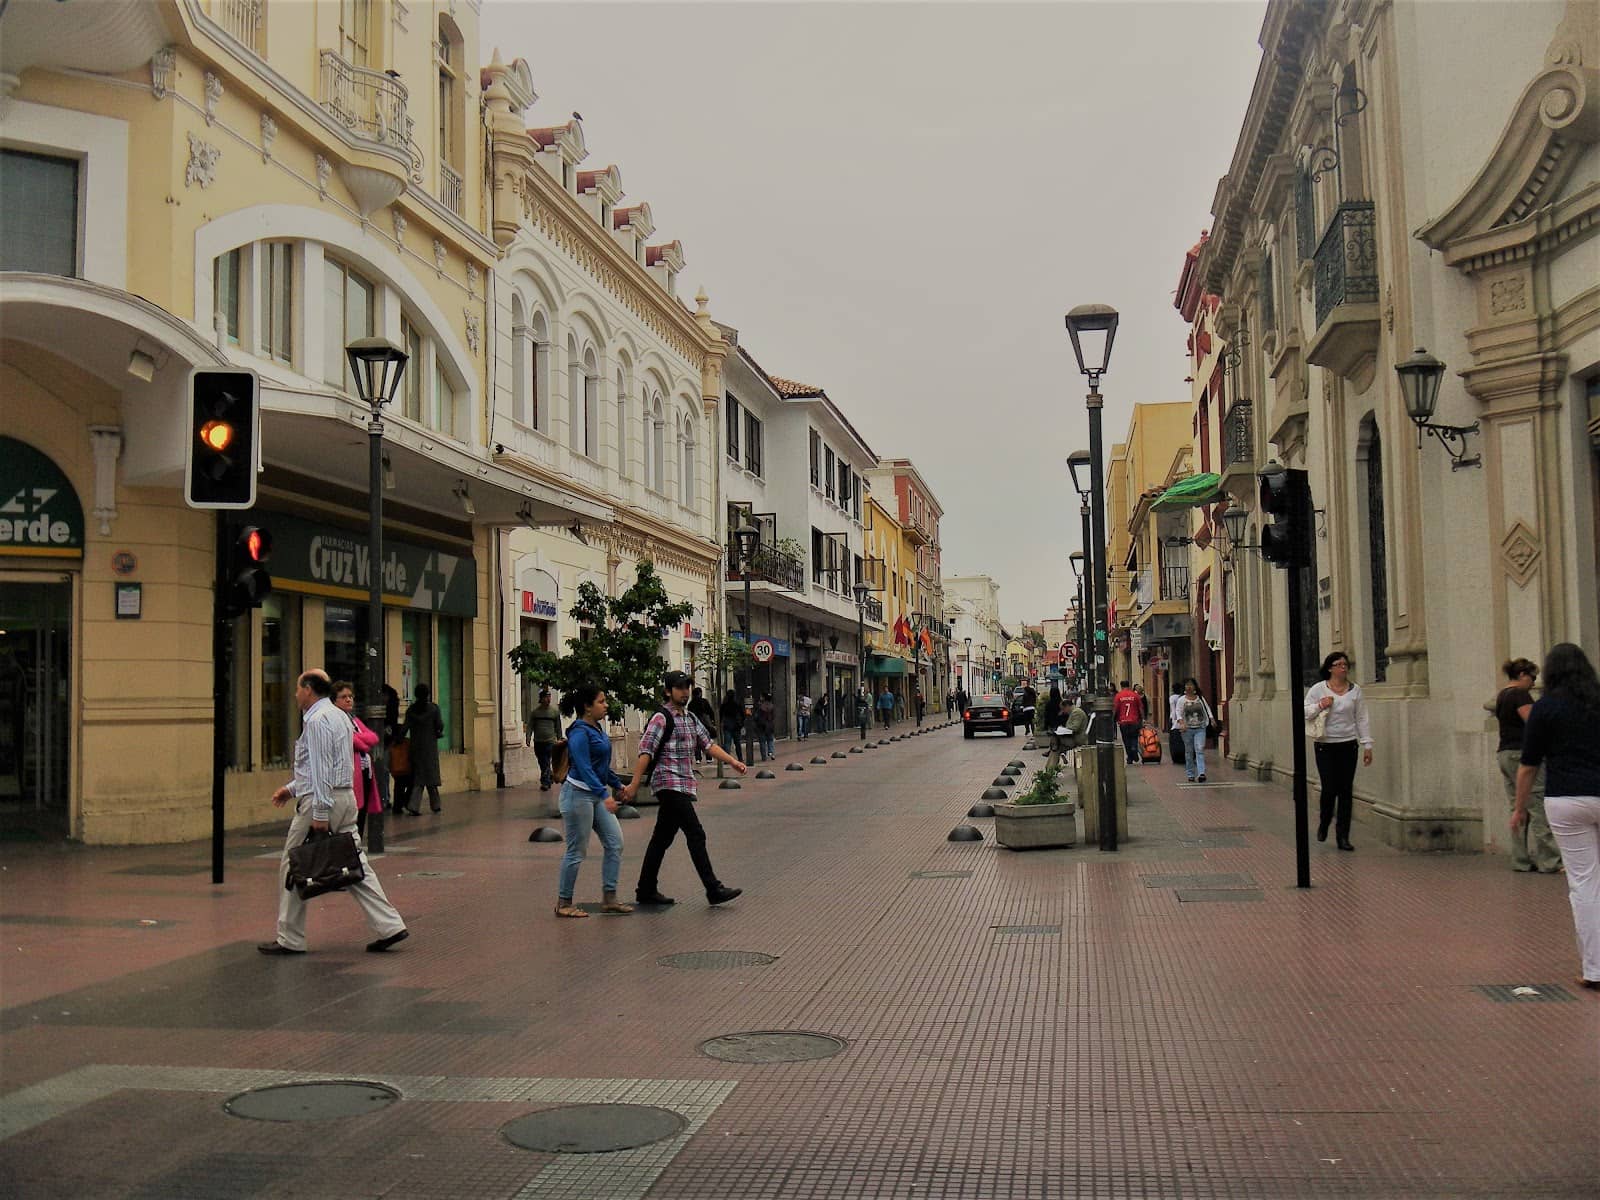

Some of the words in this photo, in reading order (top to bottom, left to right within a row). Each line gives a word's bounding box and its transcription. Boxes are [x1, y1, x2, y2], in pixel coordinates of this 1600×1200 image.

[310, 535, 353, 583] Cruz
[757, 645, 770, 656] 30
[1066, 645, 1074, 657] E
[1125, 703, 1131, 717] 7
